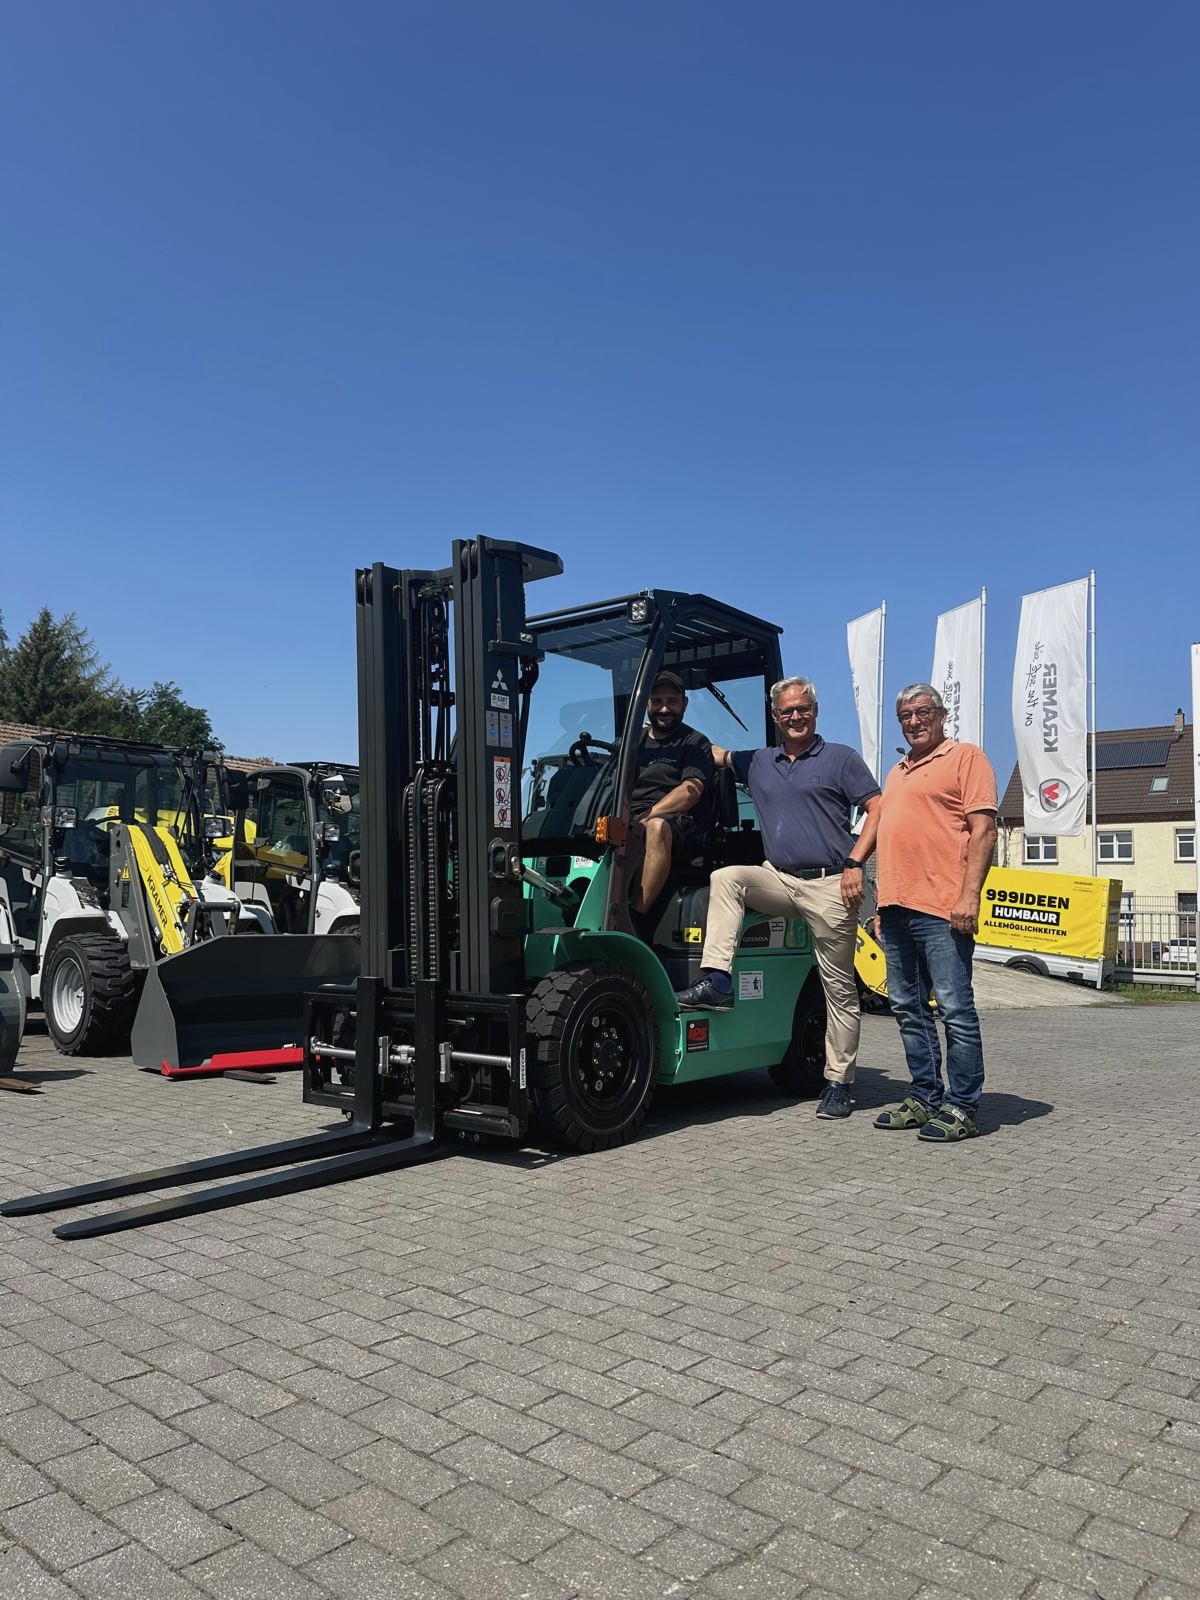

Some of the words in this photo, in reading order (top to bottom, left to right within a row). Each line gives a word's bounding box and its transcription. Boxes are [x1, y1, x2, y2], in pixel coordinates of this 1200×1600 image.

[147, 875, 167, 928] KRAMER
[995, 906, 1057, 923] HUMBAUR
[983, 920, 1067, 936] ALLEMÖGLICHKEITEN
